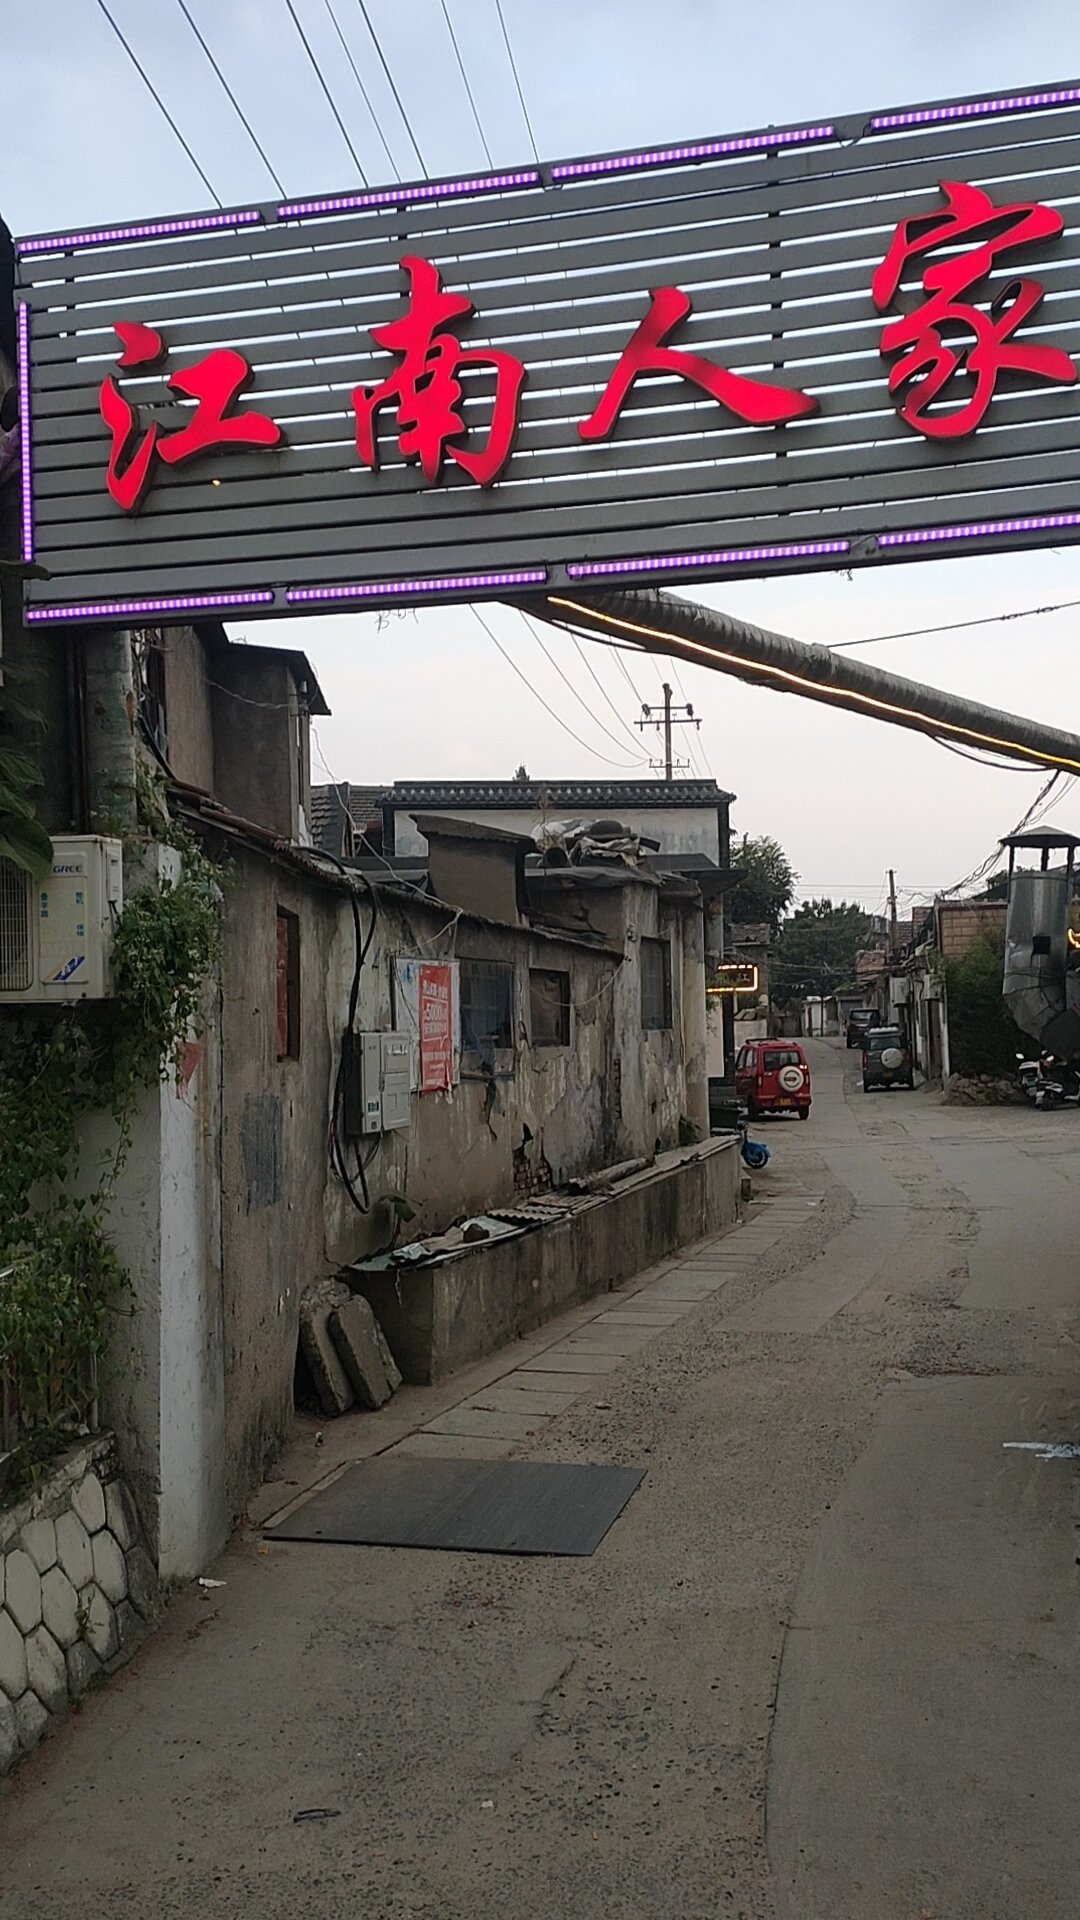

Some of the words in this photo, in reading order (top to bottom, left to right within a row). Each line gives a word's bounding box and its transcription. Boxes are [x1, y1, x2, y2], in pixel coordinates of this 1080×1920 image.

[98, 180, 1078, 510] 江南人家
[53, 864, 83, 873] GREE
